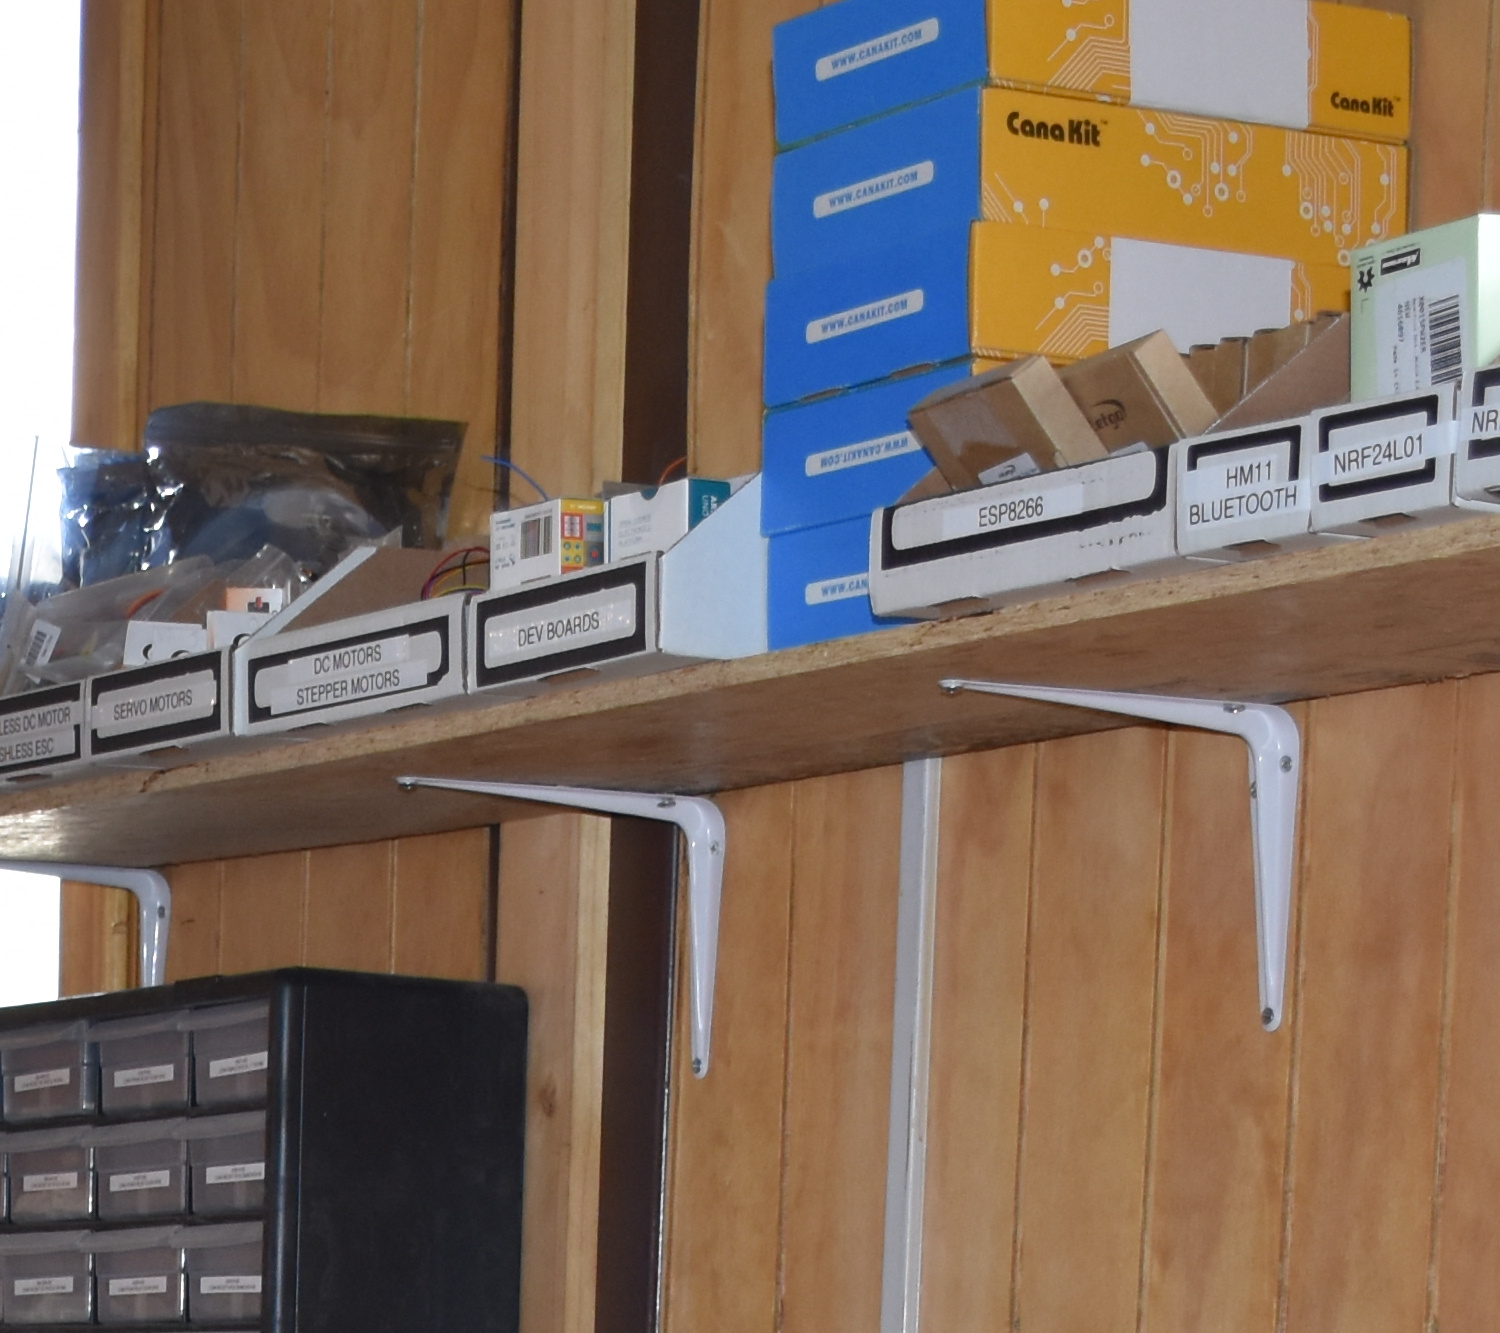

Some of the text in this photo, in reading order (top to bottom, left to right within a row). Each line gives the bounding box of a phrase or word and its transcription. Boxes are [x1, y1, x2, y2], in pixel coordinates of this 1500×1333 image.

[831, 28, 922, 70] WWW.CANAKIT.COM
[828, 171, 918, 208] WWW.CANAKIT.COM
[821, 298, 908, 334] WWW.CANAKIT.COM
[1334, 433, 1423, 475] NRF24L01
[1226, 460, 1272, 489] HM11
[978, 496, 1044, 527] ESP8266
[1189, 485, 1297, 525] BLUETOOTH
[518, 612, 600, 647] DEV BOARDS
[313, 645, 382, 675] DC MOTORS
[296, 669, 400, 705] STEPPER MOTORS
[23, 715, 36, 730] DC
[37, 707, 71, 727] MOTOR
[113, 690, 193, 721] SERVO MOTORS
[35, 738, 54, 756] ESC
